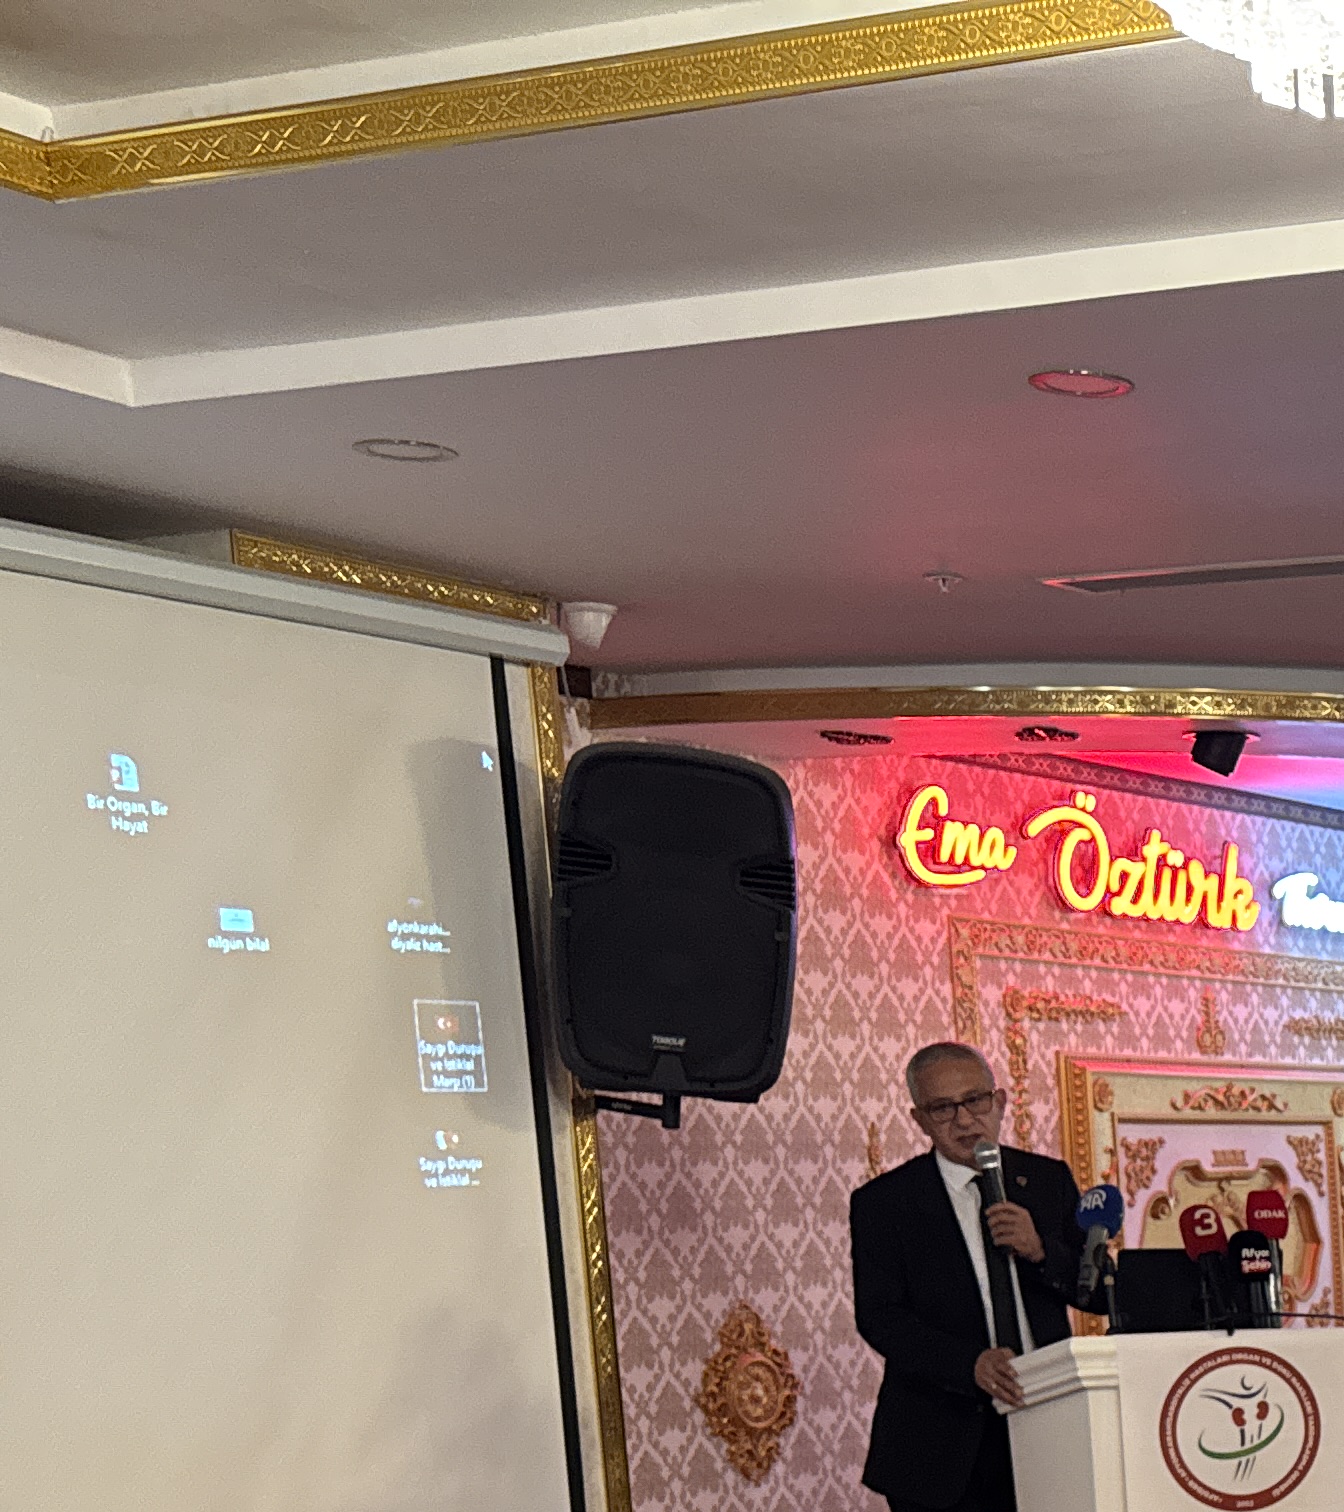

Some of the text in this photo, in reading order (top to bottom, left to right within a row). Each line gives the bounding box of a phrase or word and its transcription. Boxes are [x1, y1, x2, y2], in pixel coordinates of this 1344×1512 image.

[87, 794, 168, 816] Bir Organ, Bir
[111, 816, 148, 836] Hayat
[900, 784, 1017, 887] Ema
[1026, 790, 1260, 931] Öztürk
[1194, 1208, 1218, 1237] 3
[1253, 1208, 1287, 1220] ODAK
